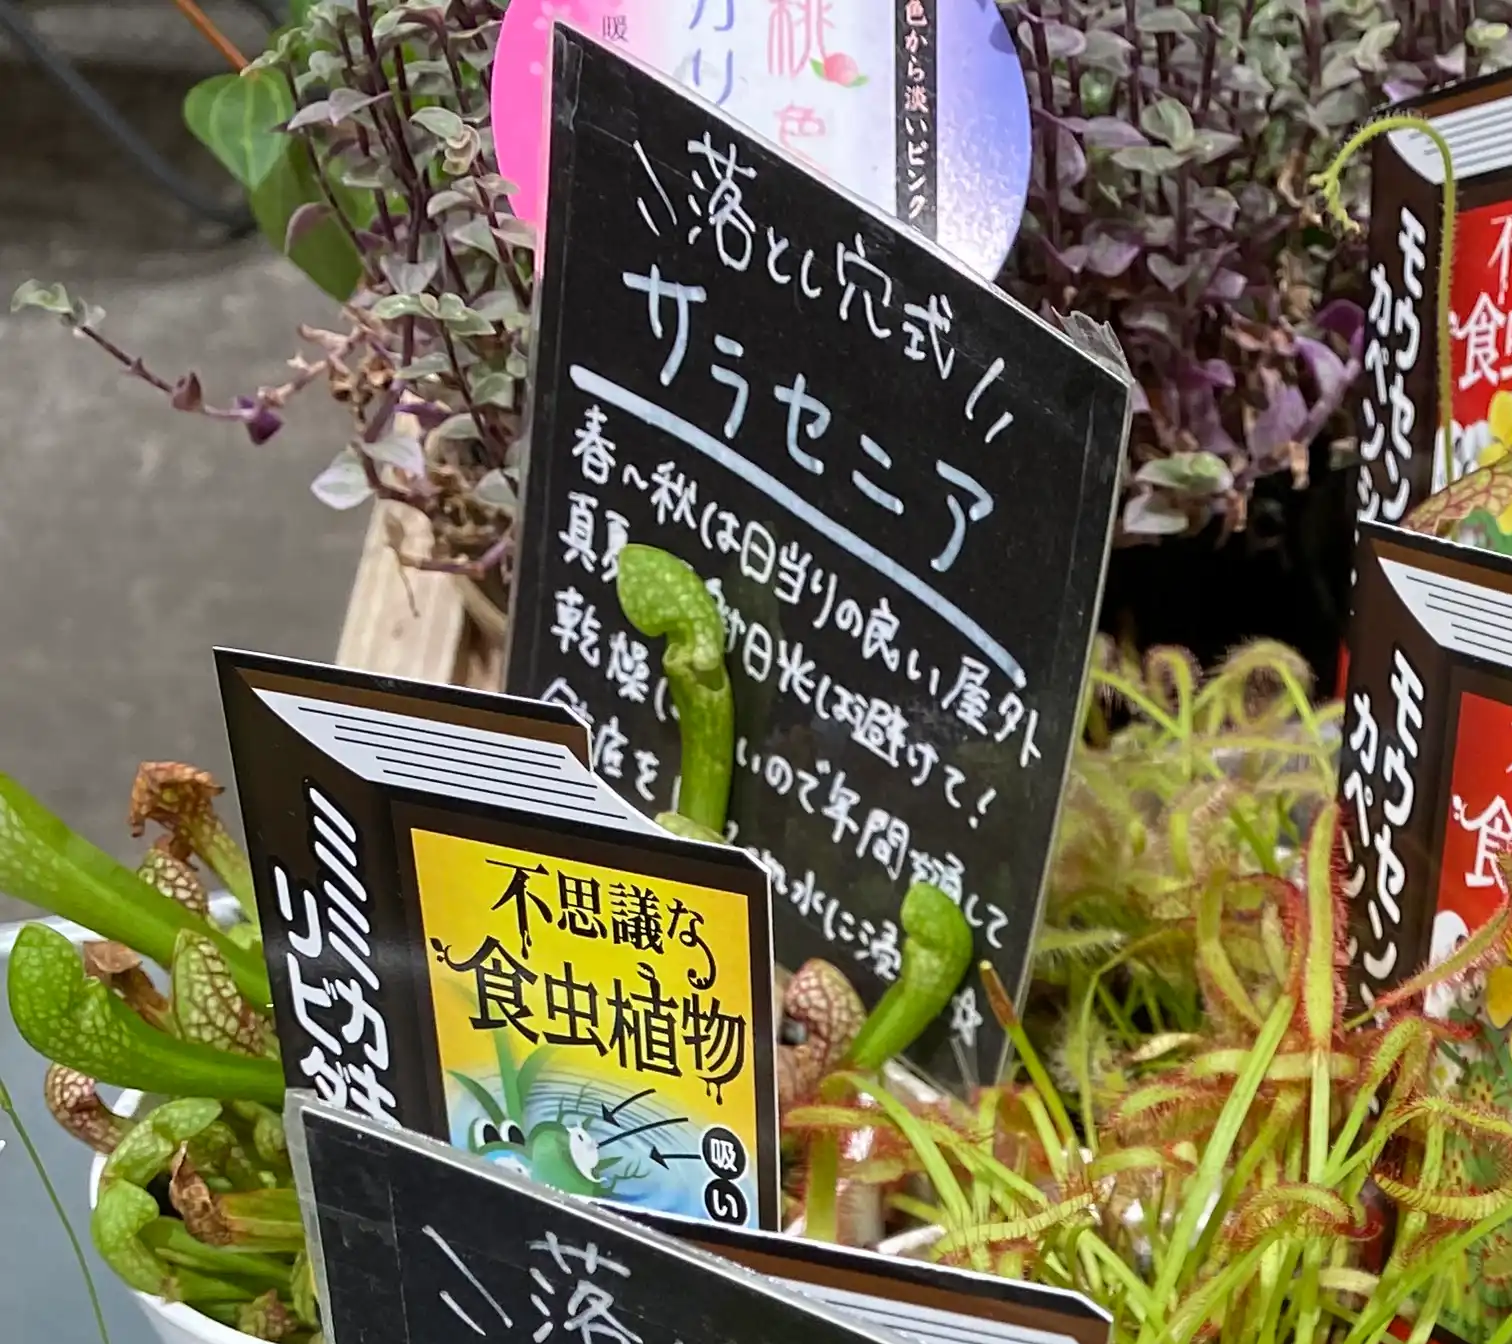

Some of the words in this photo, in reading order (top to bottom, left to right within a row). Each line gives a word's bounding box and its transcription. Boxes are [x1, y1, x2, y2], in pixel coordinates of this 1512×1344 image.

[622, 263, 994, 573] サラセニア
[485, 858, 716, 990] 不思議な
[455, 935, 747, 1102] 食虫植物
